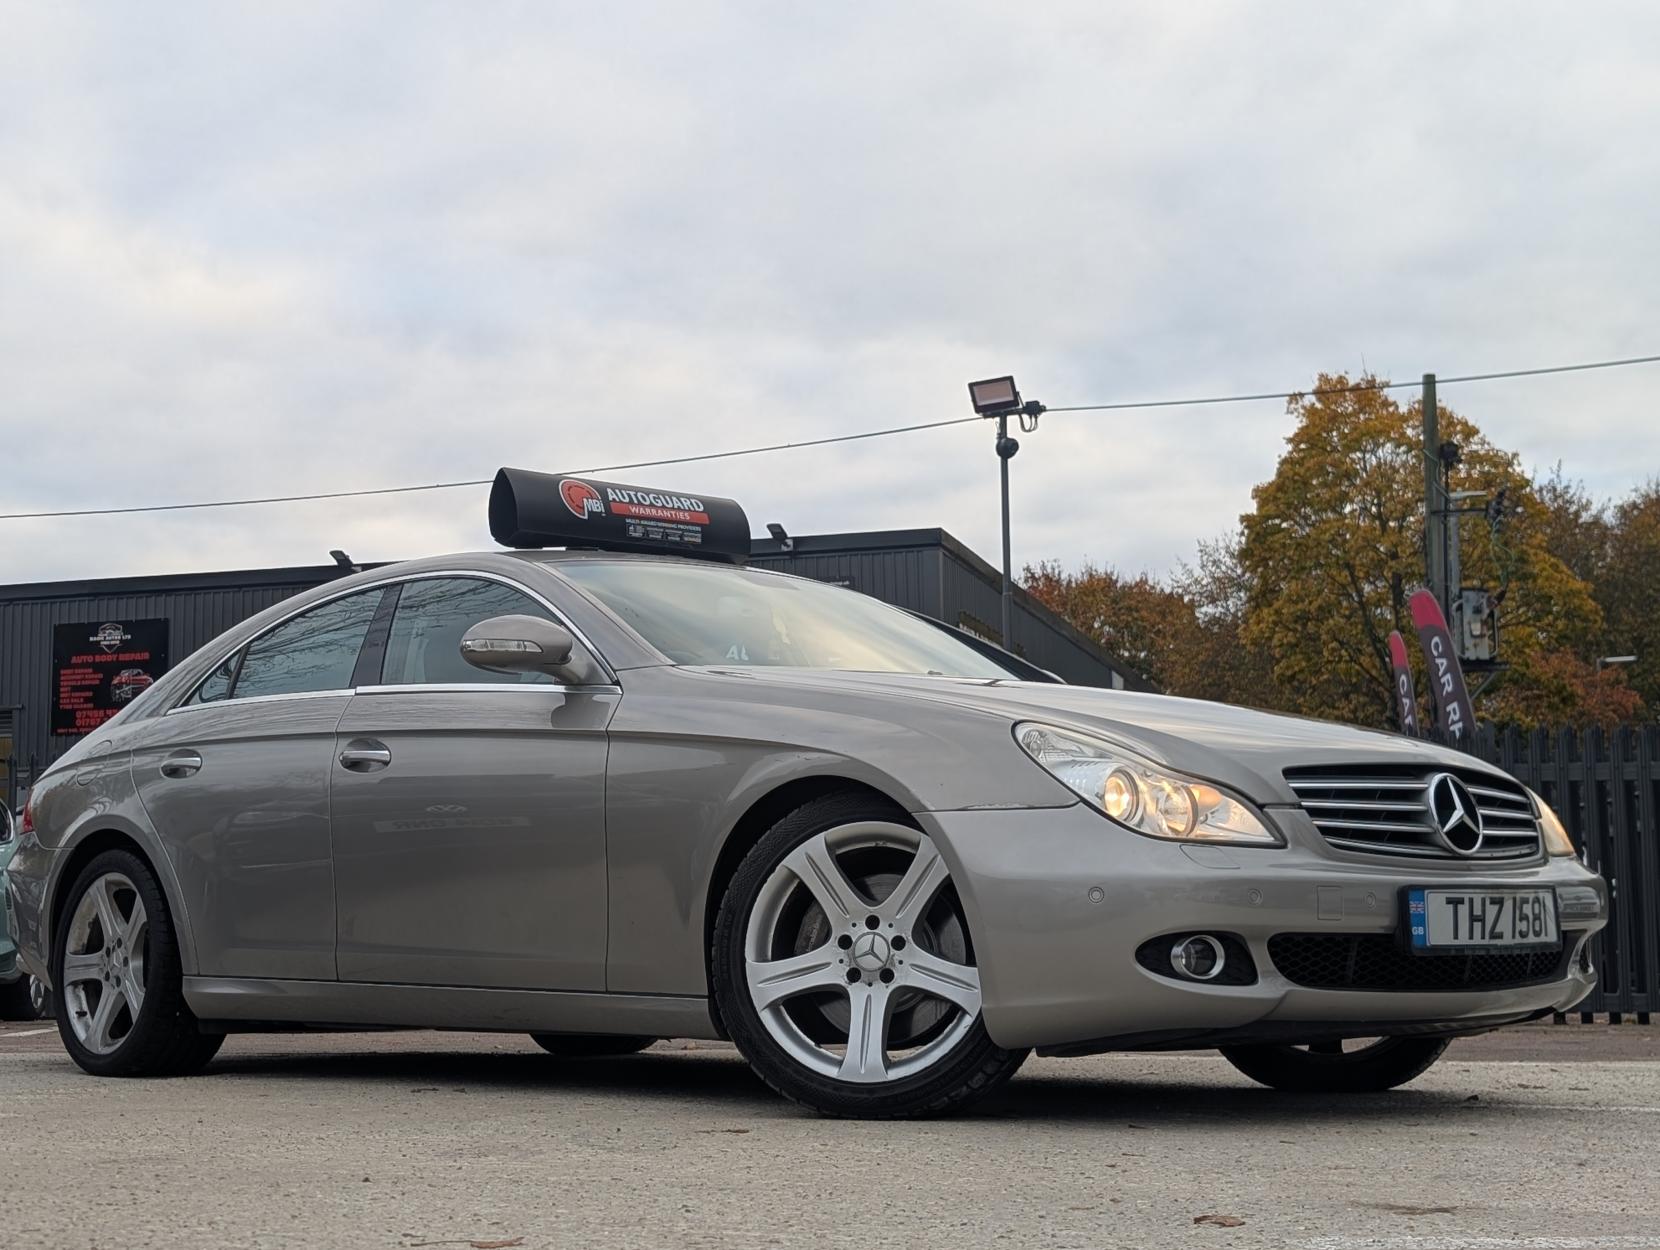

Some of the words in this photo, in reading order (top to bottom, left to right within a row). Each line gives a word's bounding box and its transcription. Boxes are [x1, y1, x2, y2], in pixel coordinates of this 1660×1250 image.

[606, 488, 704, 512] AUTOGUARD
[629, 506, 690, 520] WARRANTIES
[71, 655, 93, 664] AUTO
[95, 654, 118, 662] BODY
[118, 652, 150, 661] REPAIR
[1431, 635, 1453, 697] CAR
[1445, 896, 1505, 940] THZ
[1511, 895, 1548, 940] 1581
[1411, 926, 1424, 935] GB
